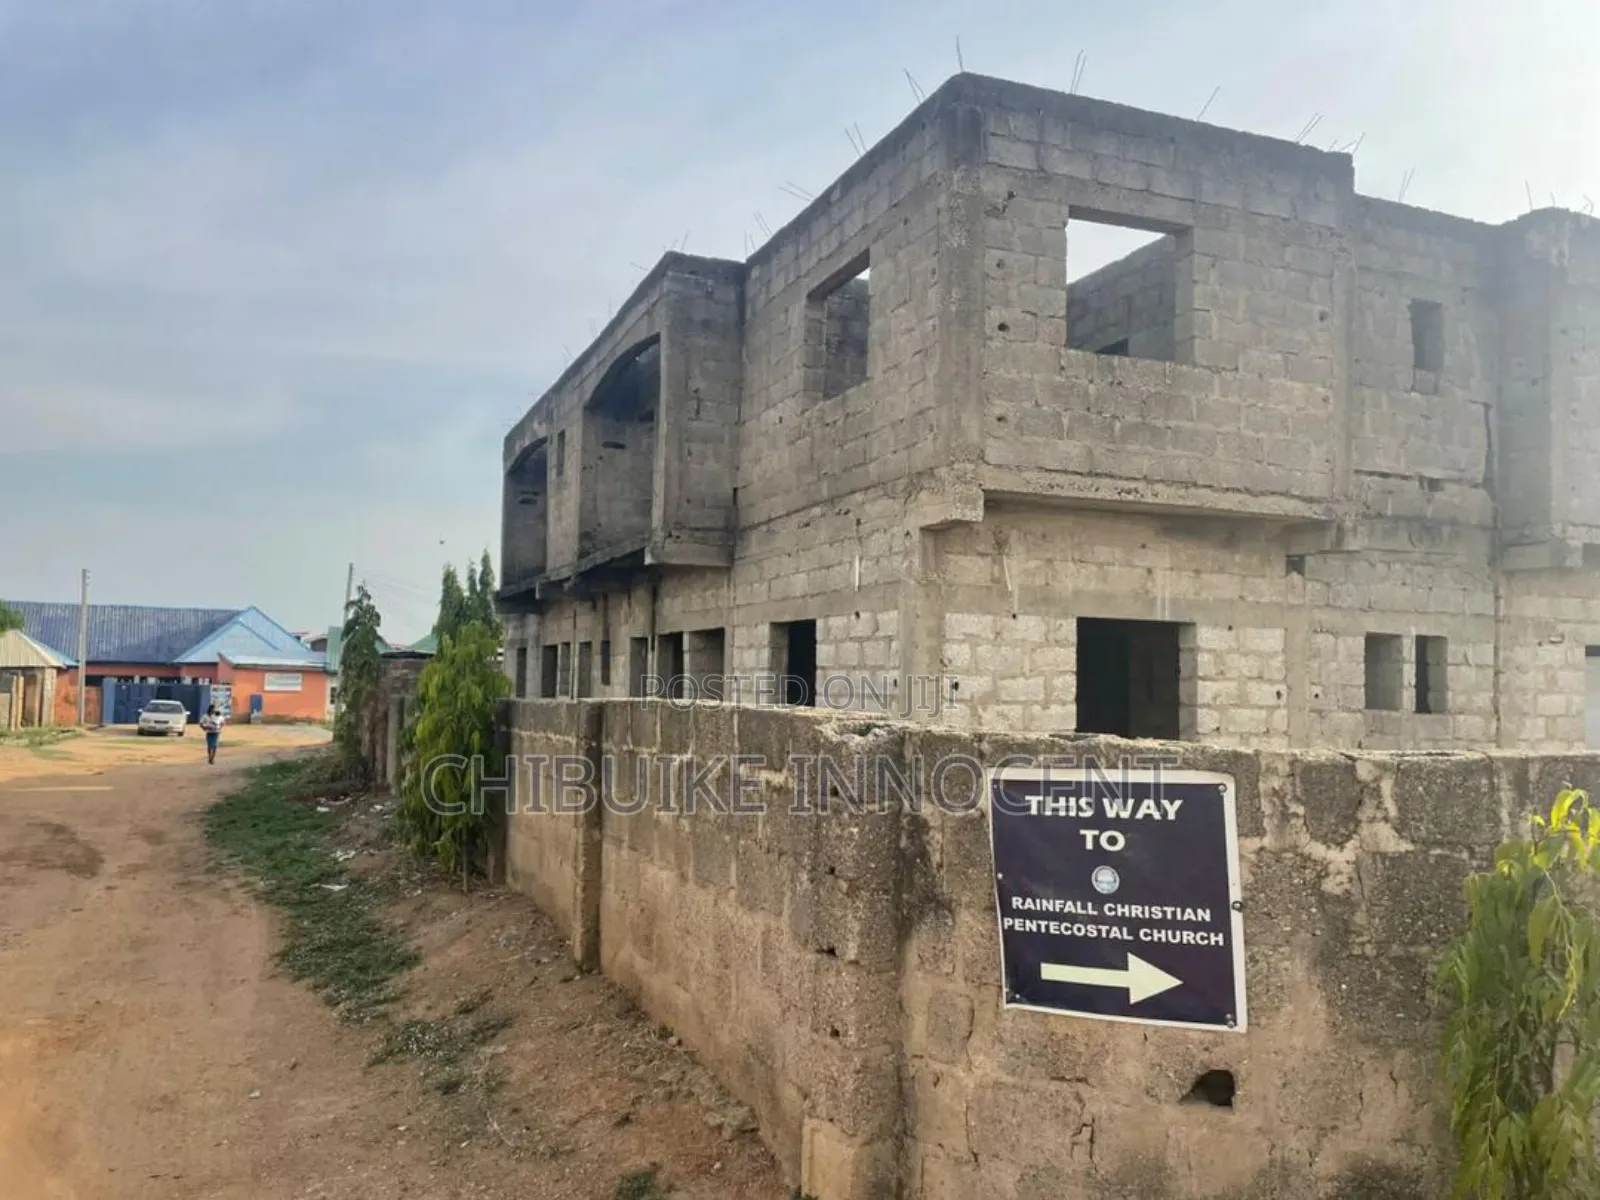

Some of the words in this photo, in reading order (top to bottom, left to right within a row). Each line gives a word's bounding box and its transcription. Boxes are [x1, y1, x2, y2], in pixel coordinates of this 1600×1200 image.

[1024, 795, 1094, 817] THIS
[1102, 799, 1184, 821] WAY
[1079, 829, 1126, 851] TO
[1011, 896, 1098, 915] RAINFALL
[1103, 903, 1211, 922] CHRISTIAN
[1003, 918, 1134, 940] PENTECOSTAL
[1138, 928, 1225, 947] CHURCH
